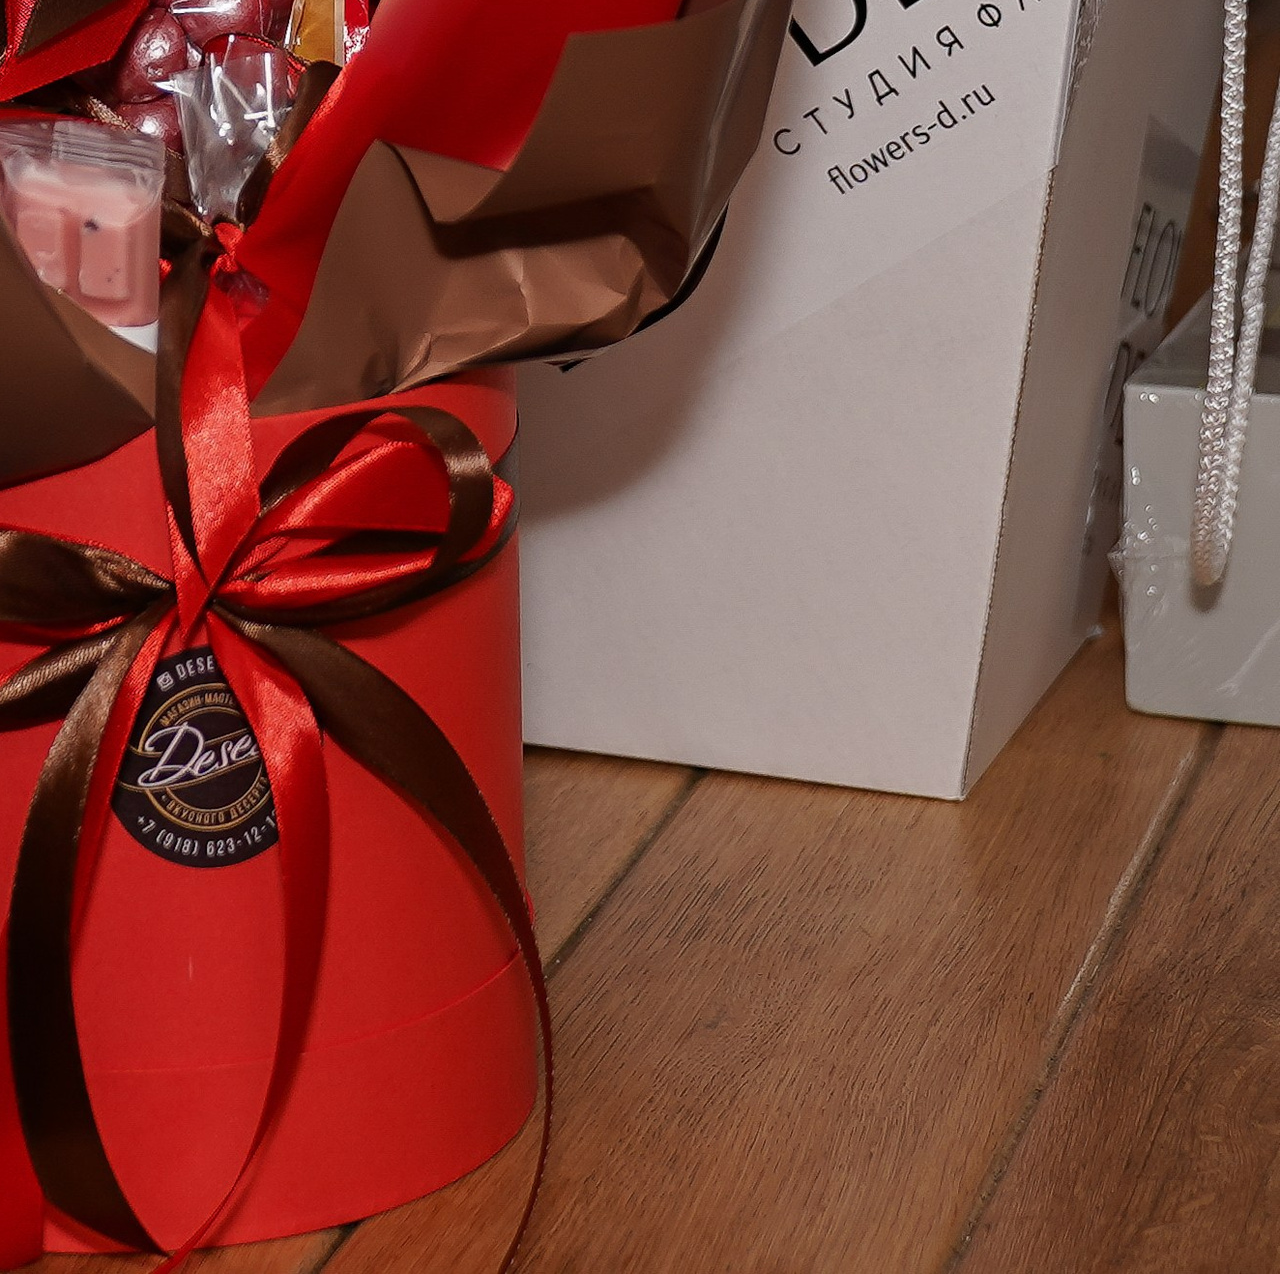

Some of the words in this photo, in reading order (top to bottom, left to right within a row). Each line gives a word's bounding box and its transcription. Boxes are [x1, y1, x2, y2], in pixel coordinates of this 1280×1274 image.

[773, 25, 964, 155] СТУДИЯ
[827, 84, 996, 195] flowers-d.ru
[156, 829, 199, 856] (918)
